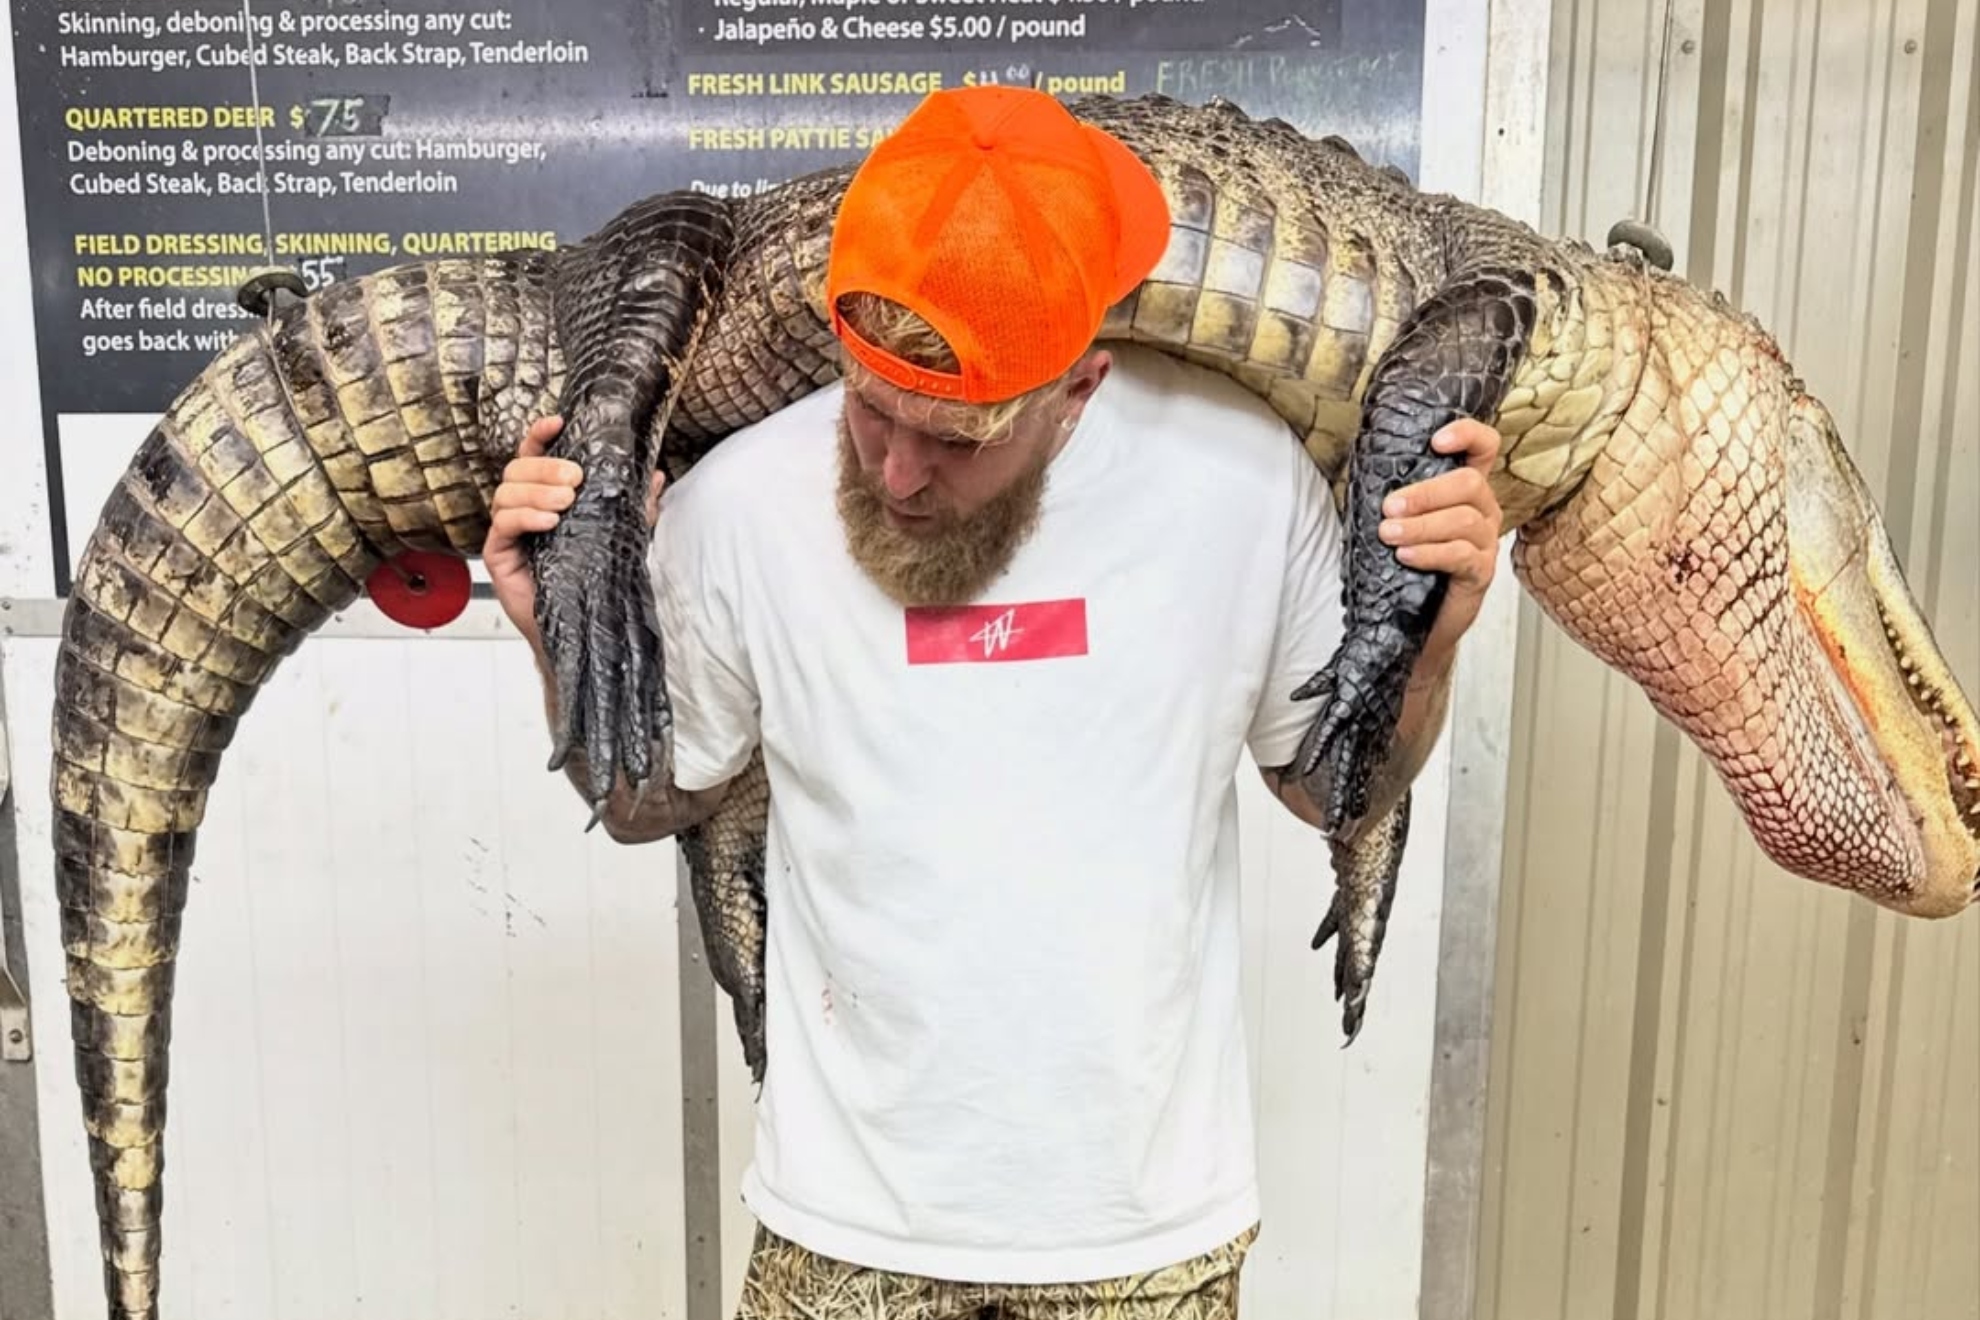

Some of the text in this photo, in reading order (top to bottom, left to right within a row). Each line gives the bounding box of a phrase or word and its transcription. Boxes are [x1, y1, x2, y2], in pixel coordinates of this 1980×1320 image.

[58, 9, 513, 38] Skinning, deboning & processing any cut:
[714, 14, 1086, 45] Jalapeño & Cheese $5.00 / pound
[61, 40, 588, 71] Hamburger, Cubed Steak, Back Strap, Tenderloin
[688, 73, 763, 95] FRESH
[769, 73, 826, 95] LINK
[830, 72, 942, 94] SAUSAGE
[1048, 71, 1125, 95] pound
[65, 107, 208, 131] QUARTERED
[214, 106, 276, 129] DEER
[688, 128, 764, 150] FRESH
[770, 127, 850, 149] PATTIE
[67, 139, 547, 167] Deboning & processing any cut: Hamburger,
[69, 170, 458, 198] Cubed Steak, Back Strap, Tenderloin
[731, 180, 753, 199] to
[74, 231, 557, 257] FIELD DRESSING, SKINNING, QUARTERING
[78, 266, 113, 287] NO
[118, 265, 264, 288] PROCESSIN
[81, 298, 134, 319] After
[138, 297, 186, 319] field
[82, 334, 134, 356] goes
[139, 329, 190, 351] back
